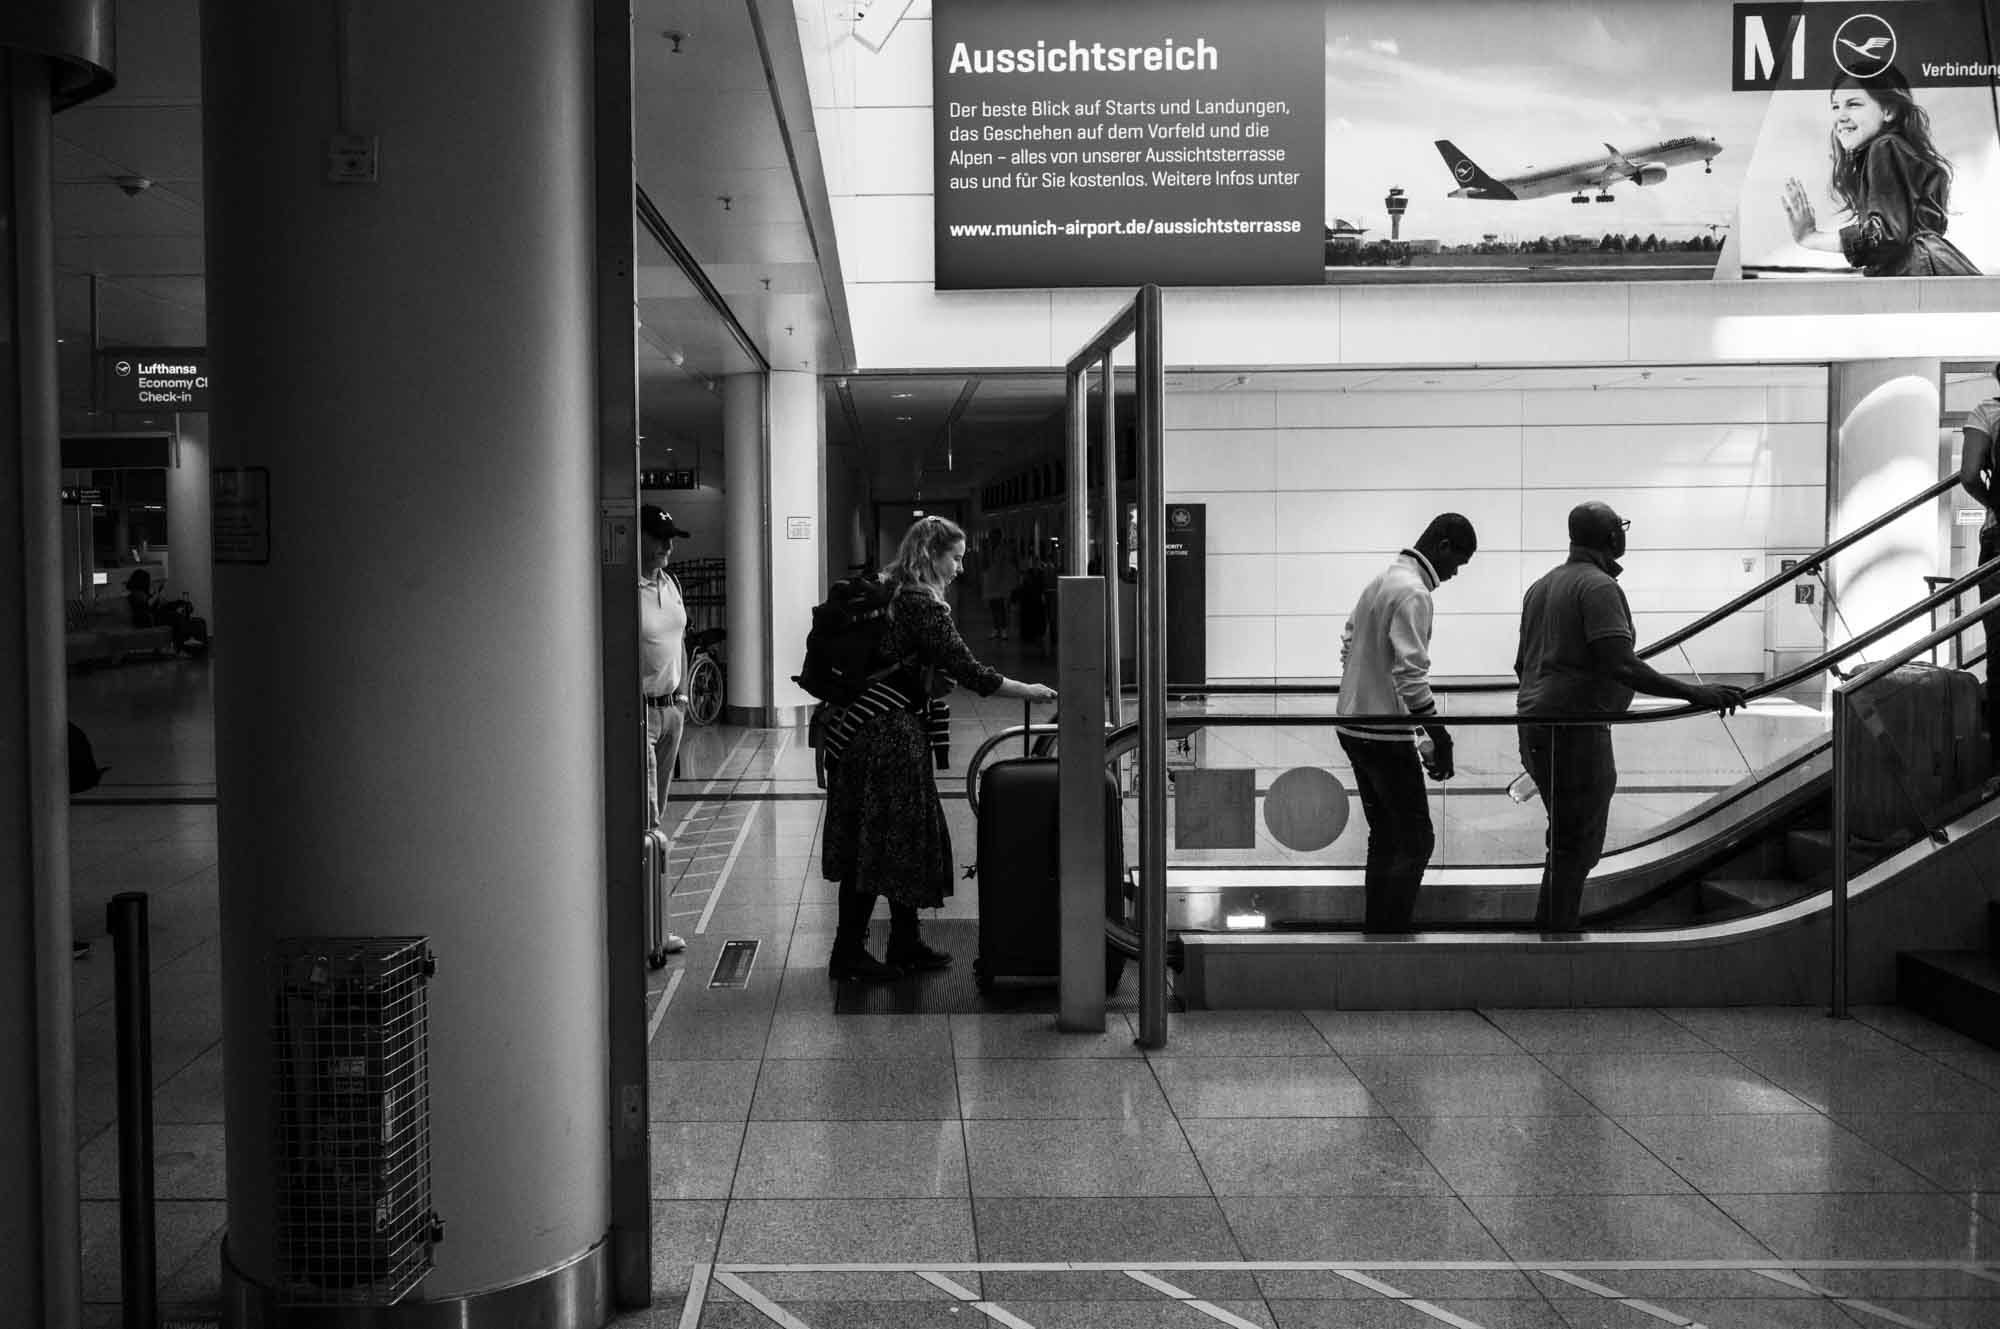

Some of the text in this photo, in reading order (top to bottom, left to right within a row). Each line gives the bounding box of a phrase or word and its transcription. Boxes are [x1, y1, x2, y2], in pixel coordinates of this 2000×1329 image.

[949, 38, 1218, 73] Aussichtsreich
[949, 99, 1290, 118] Der beste Blick auf Starts und Landungen,
[949, 122, 1270, 141] das Geschehen auf dem Vorfeld und die
[949, 150, 993, 168] Alpen
[1010, 148, 1048, 165] alles
[1050, 152, 1078, 165] von
[1082, 151, 1143, 164] unserer
[1145, 146, 1286, 163] Aussichtsterrasse
[949, 170, 1301, 190] aus und für Sie kostenlos. Weitere Infos unter
[949, 218, 1302, 239] www.munich-airport.de/aussichtsterrasse
[138, 363, 197, 375] Lufthansa
[138, 377, 194, 390] Economy
[139, 391, 192, 402] Check-in
